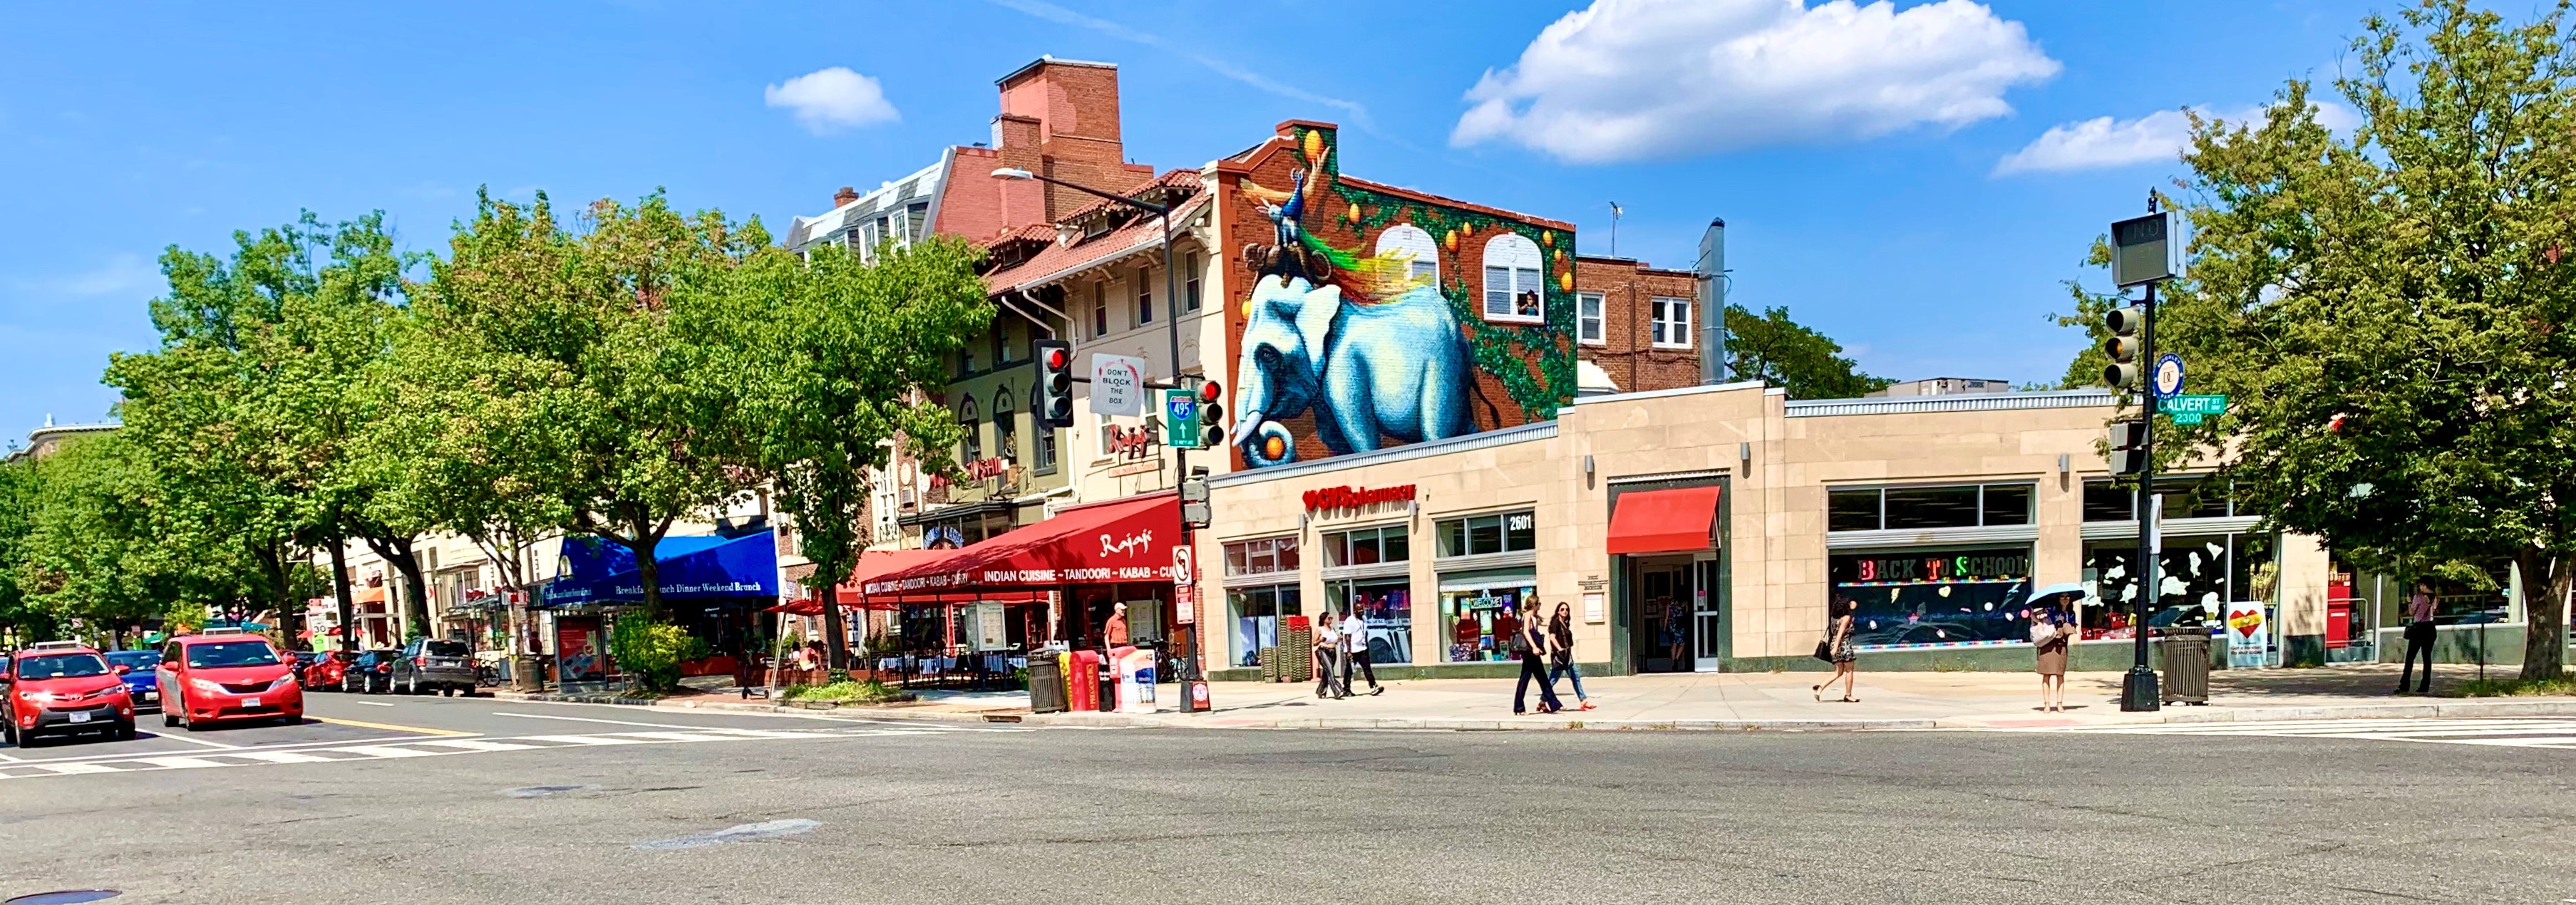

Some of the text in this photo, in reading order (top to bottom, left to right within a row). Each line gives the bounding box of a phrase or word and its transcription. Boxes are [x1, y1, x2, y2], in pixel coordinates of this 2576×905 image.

[1102, 377, 1131, 386] BLOCK
[1173, 402, 1190, 416] 495
[2158, 398, 2211, 412] CALVERT
[2175, 413, 2202, 423] 2300
[1510, 514, 1532, 531] 2601
[1099, 529, 1153, 558] Rajaji
[984, 571, 1016, 581] INDIAN
[1019, 569, 1056, 581] CUISINE
[1064, 568, 1111, 580] TANDOORI
[1120, 567, 1150, 579] KABAB
[1858, 556, 2028, 580] BACK TO SCHOOL
[616, 585, 644, 594] Breakfa
[676, 584, 701, 593] Dinner
[702, 582, 733, 592] Weekend
[735, 581, 761, 591] Brunch
[902, 577, 926, 590] TANDOORI
[929, 575, 947, 586] KABAB
[951, 572, 968, 585] CURRY
